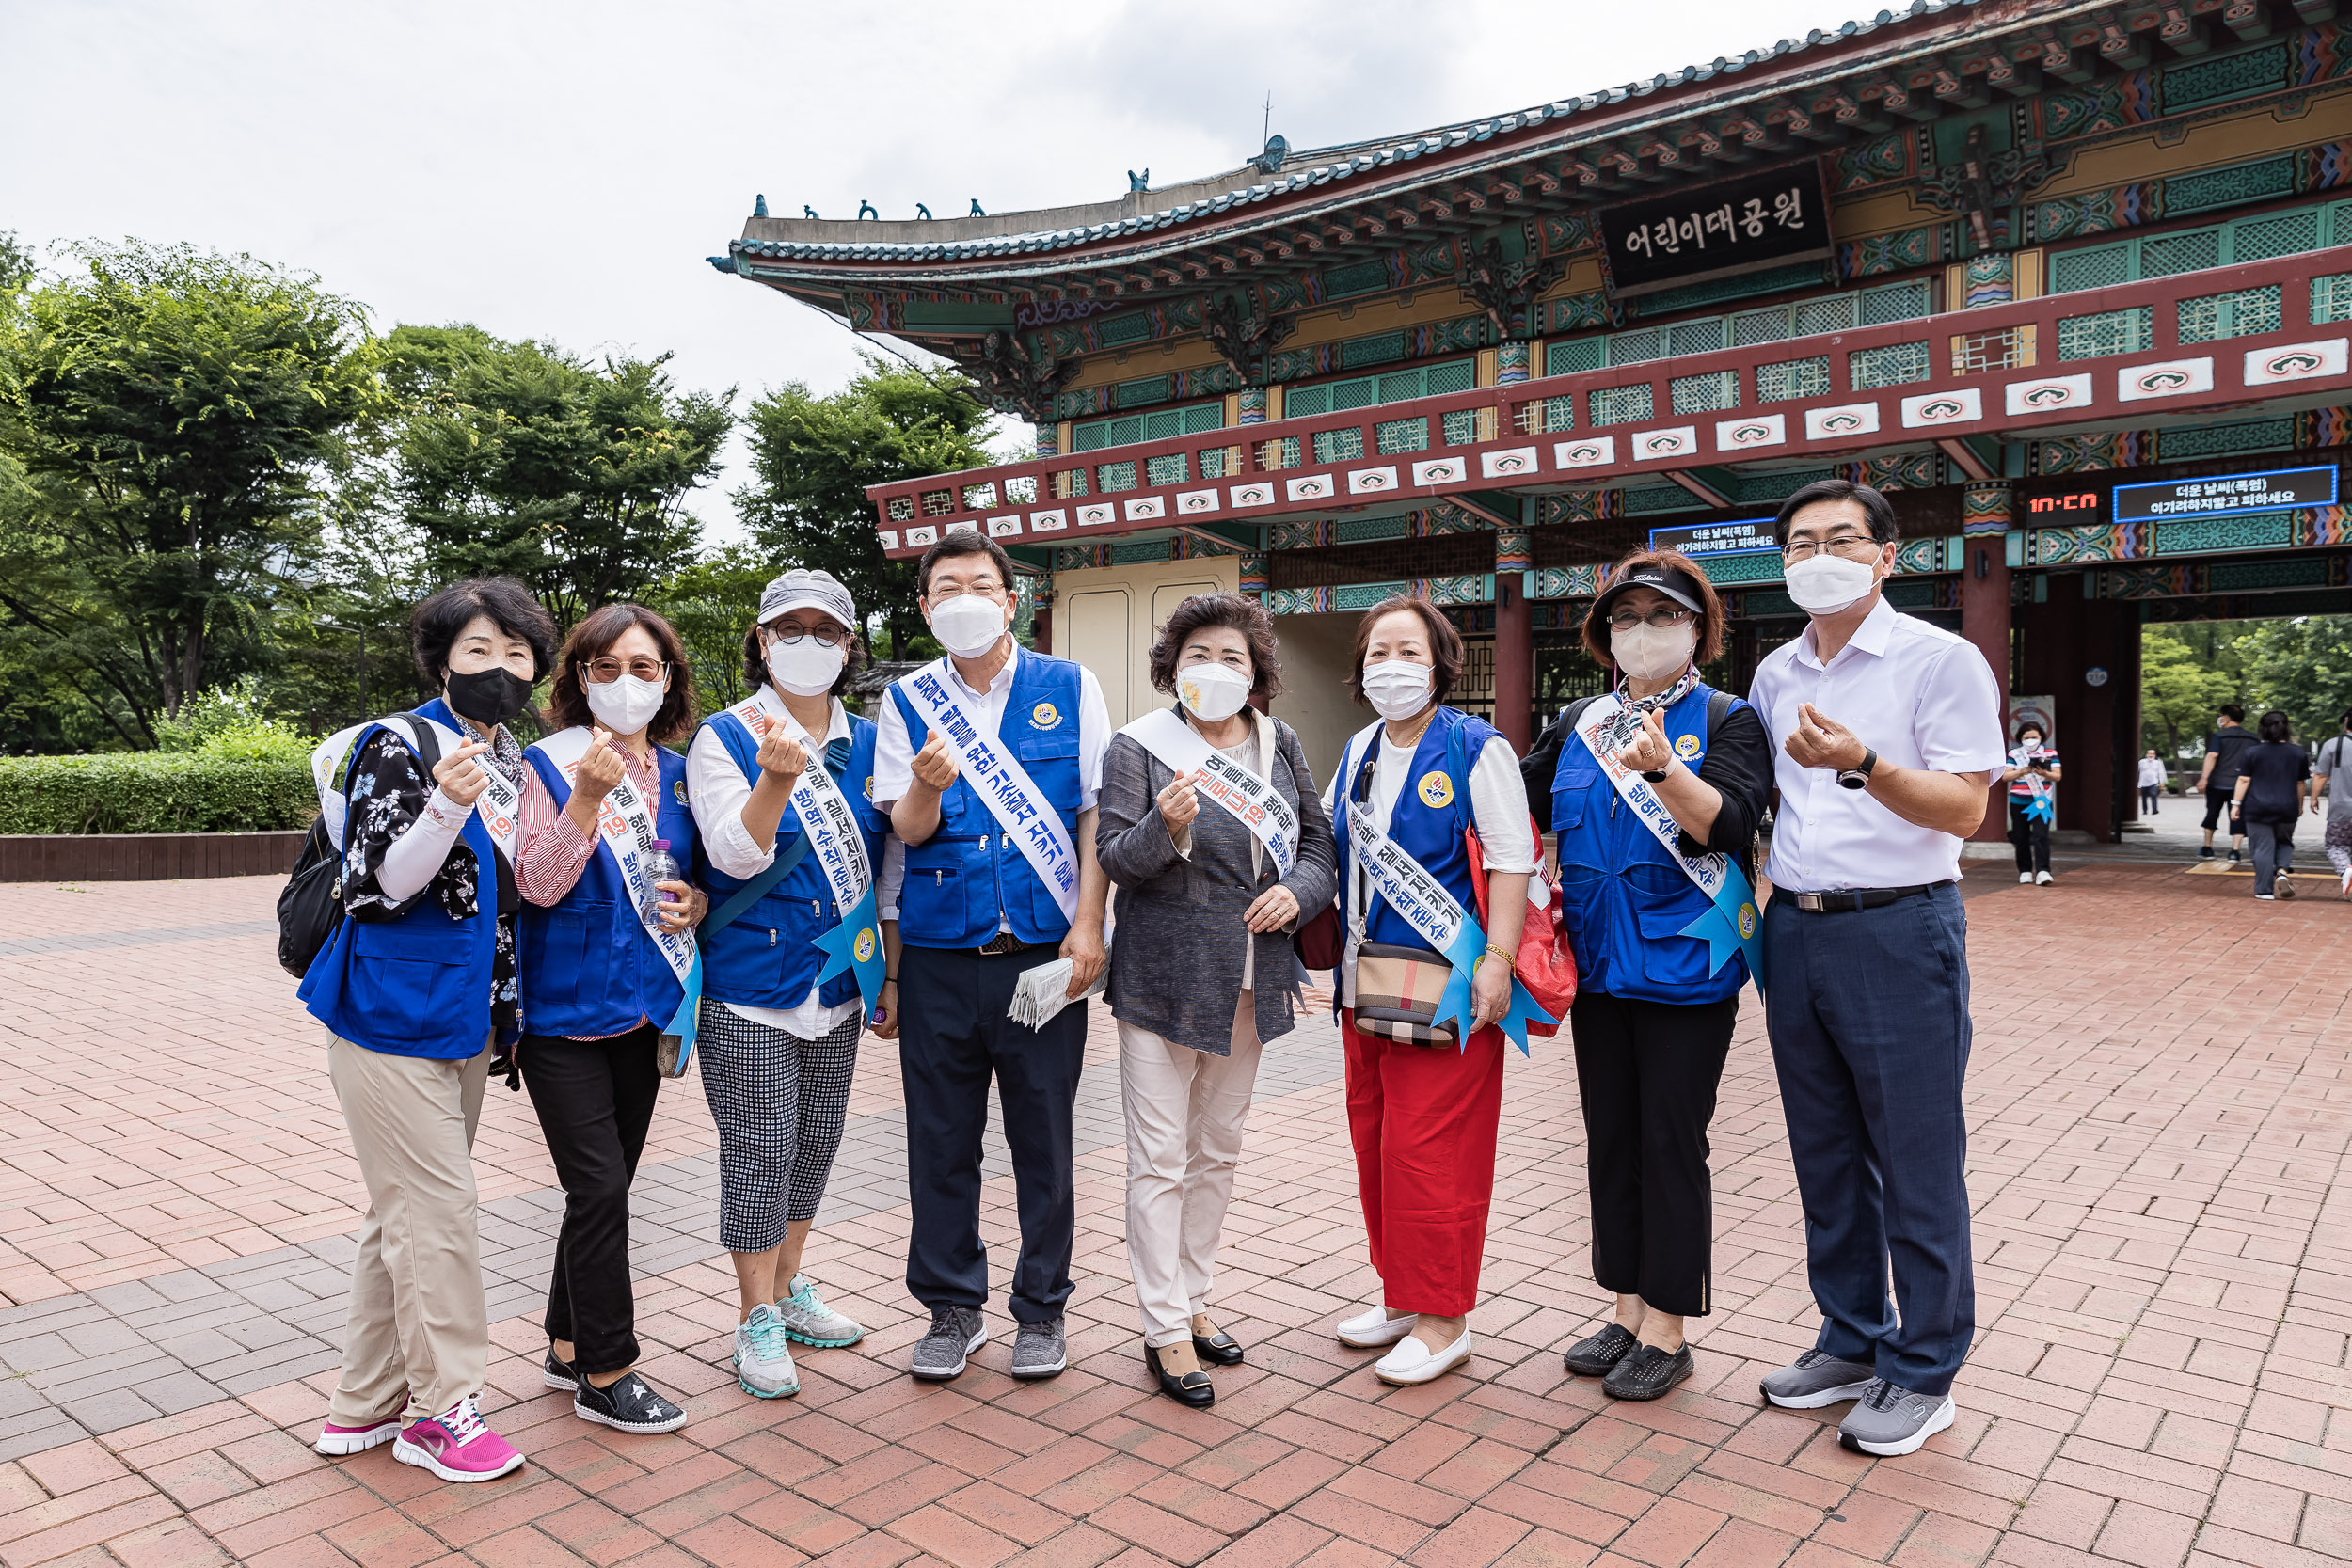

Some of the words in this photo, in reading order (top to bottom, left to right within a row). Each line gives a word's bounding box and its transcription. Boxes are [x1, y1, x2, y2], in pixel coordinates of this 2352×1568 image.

[1626, 187, 1804, 258] 어린이대공원
[2150, 496, 2239, 515] 이기려하지말고
[2241, 490, 2296, 507] 피하세요
[2175, 485, 2201, 499] 더운
[2203, 478, 2267, 496] 날씨(폭염)
[1692, 530, 1711, 540] 더운
[1737, 536, 1774, 548] 피하세요
[912, 673, 949, 711] 법질서
[939, 704, 977, 749] 확립을
[966, 741, 999, 776] 위한
[986, 768, 1037, 826] 기초질서
[1025, 819, 1064, 866] 지키기
[1054, 860, 1074, 893] 운동
[1193, 768, 1264, 825] 코로나19
[1205, 753, 1263, 797] 여름철
[1263, 795, 1294, 832] 행락
[1627, 782, 1663, 821] 방역
[628, 812, 656, 854] 행락
[793, 788, 826, 826] 방역
[816, 828, 855, 906] 수칙준수
[823, 798, 870, 895] 질서지키기
[623, 852, 644, 892] 방역
[1359, 847, 1385, 883] 방역
[1383, 876, 1449, 942] 수칙준수
[1376, 844, 1463, 926] 질서지키기
